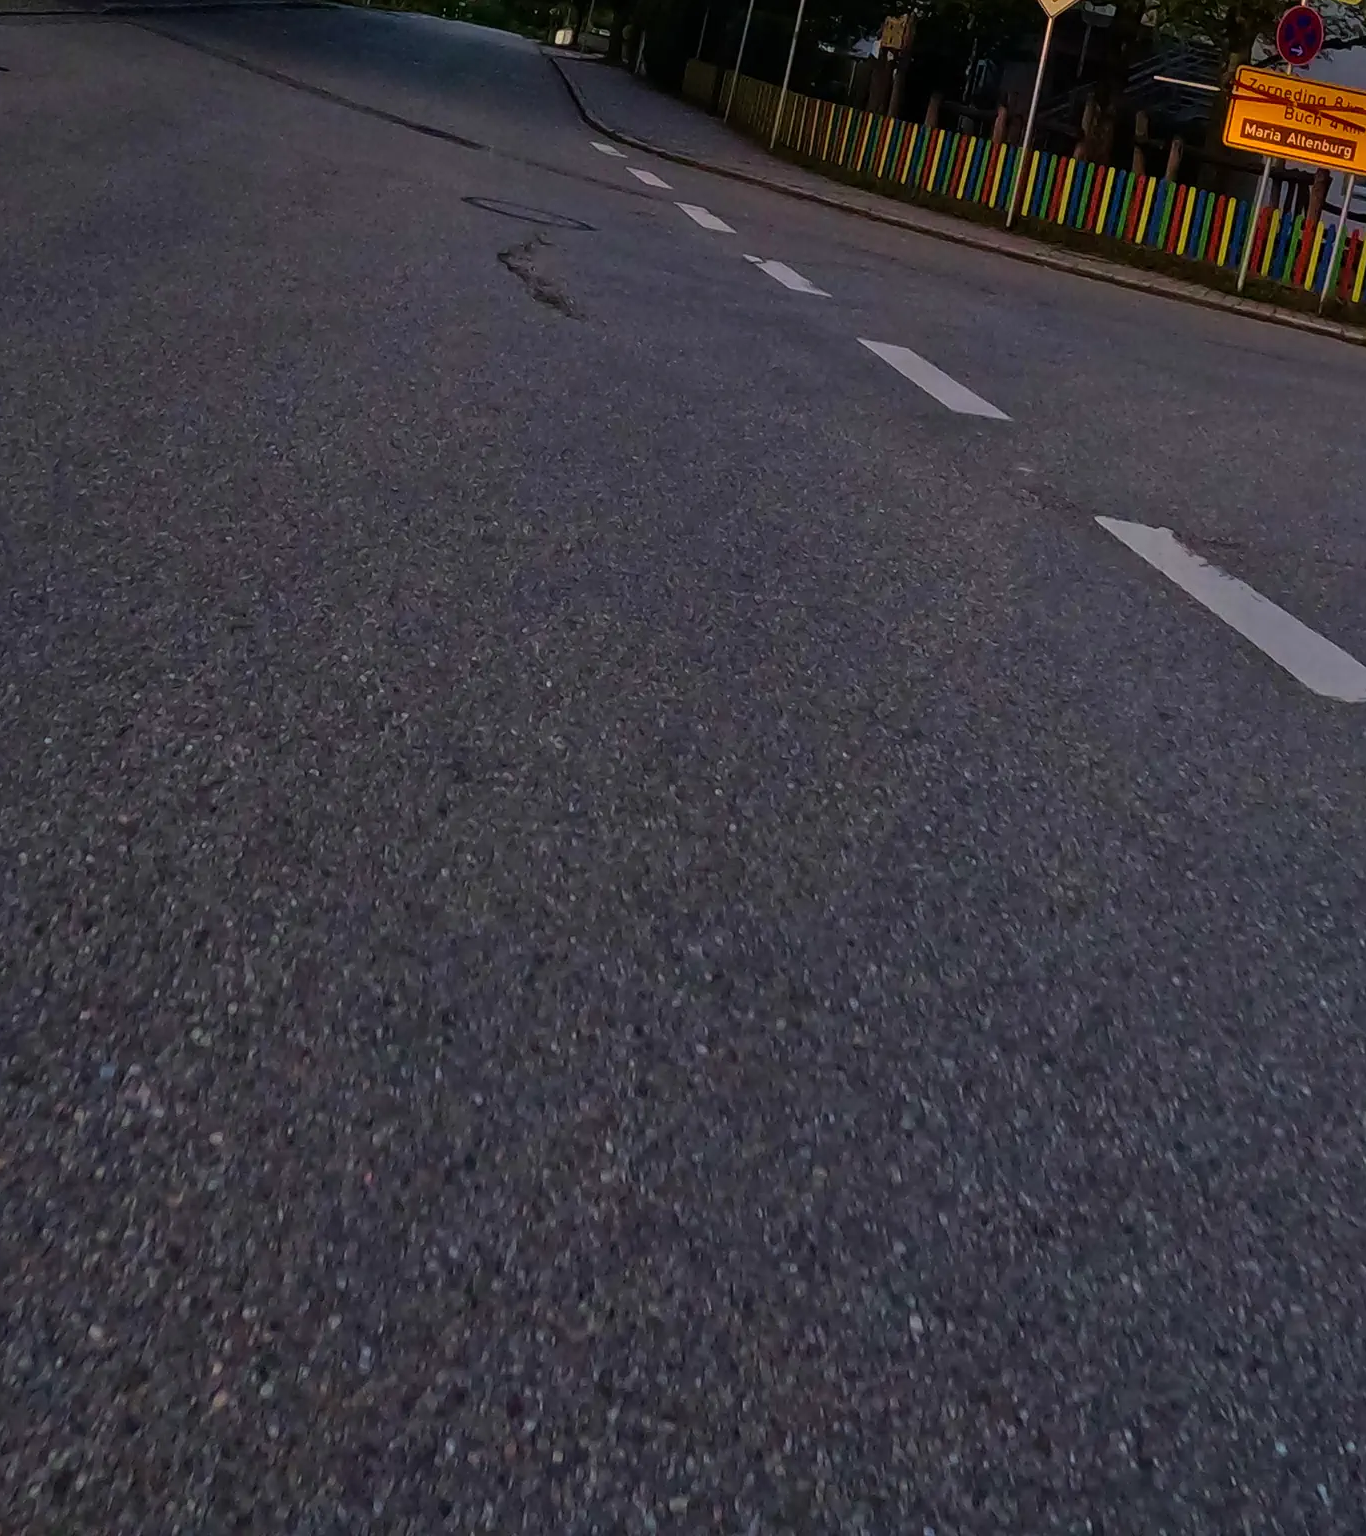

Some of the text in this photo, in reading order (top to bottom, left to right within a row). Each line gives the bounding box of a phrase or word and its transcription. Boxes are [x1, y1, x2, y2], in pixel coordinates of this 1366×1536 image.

[1284, 106, 1323, 128] Buch
[1244, 121, 1353, 160] Maria Altenburg
